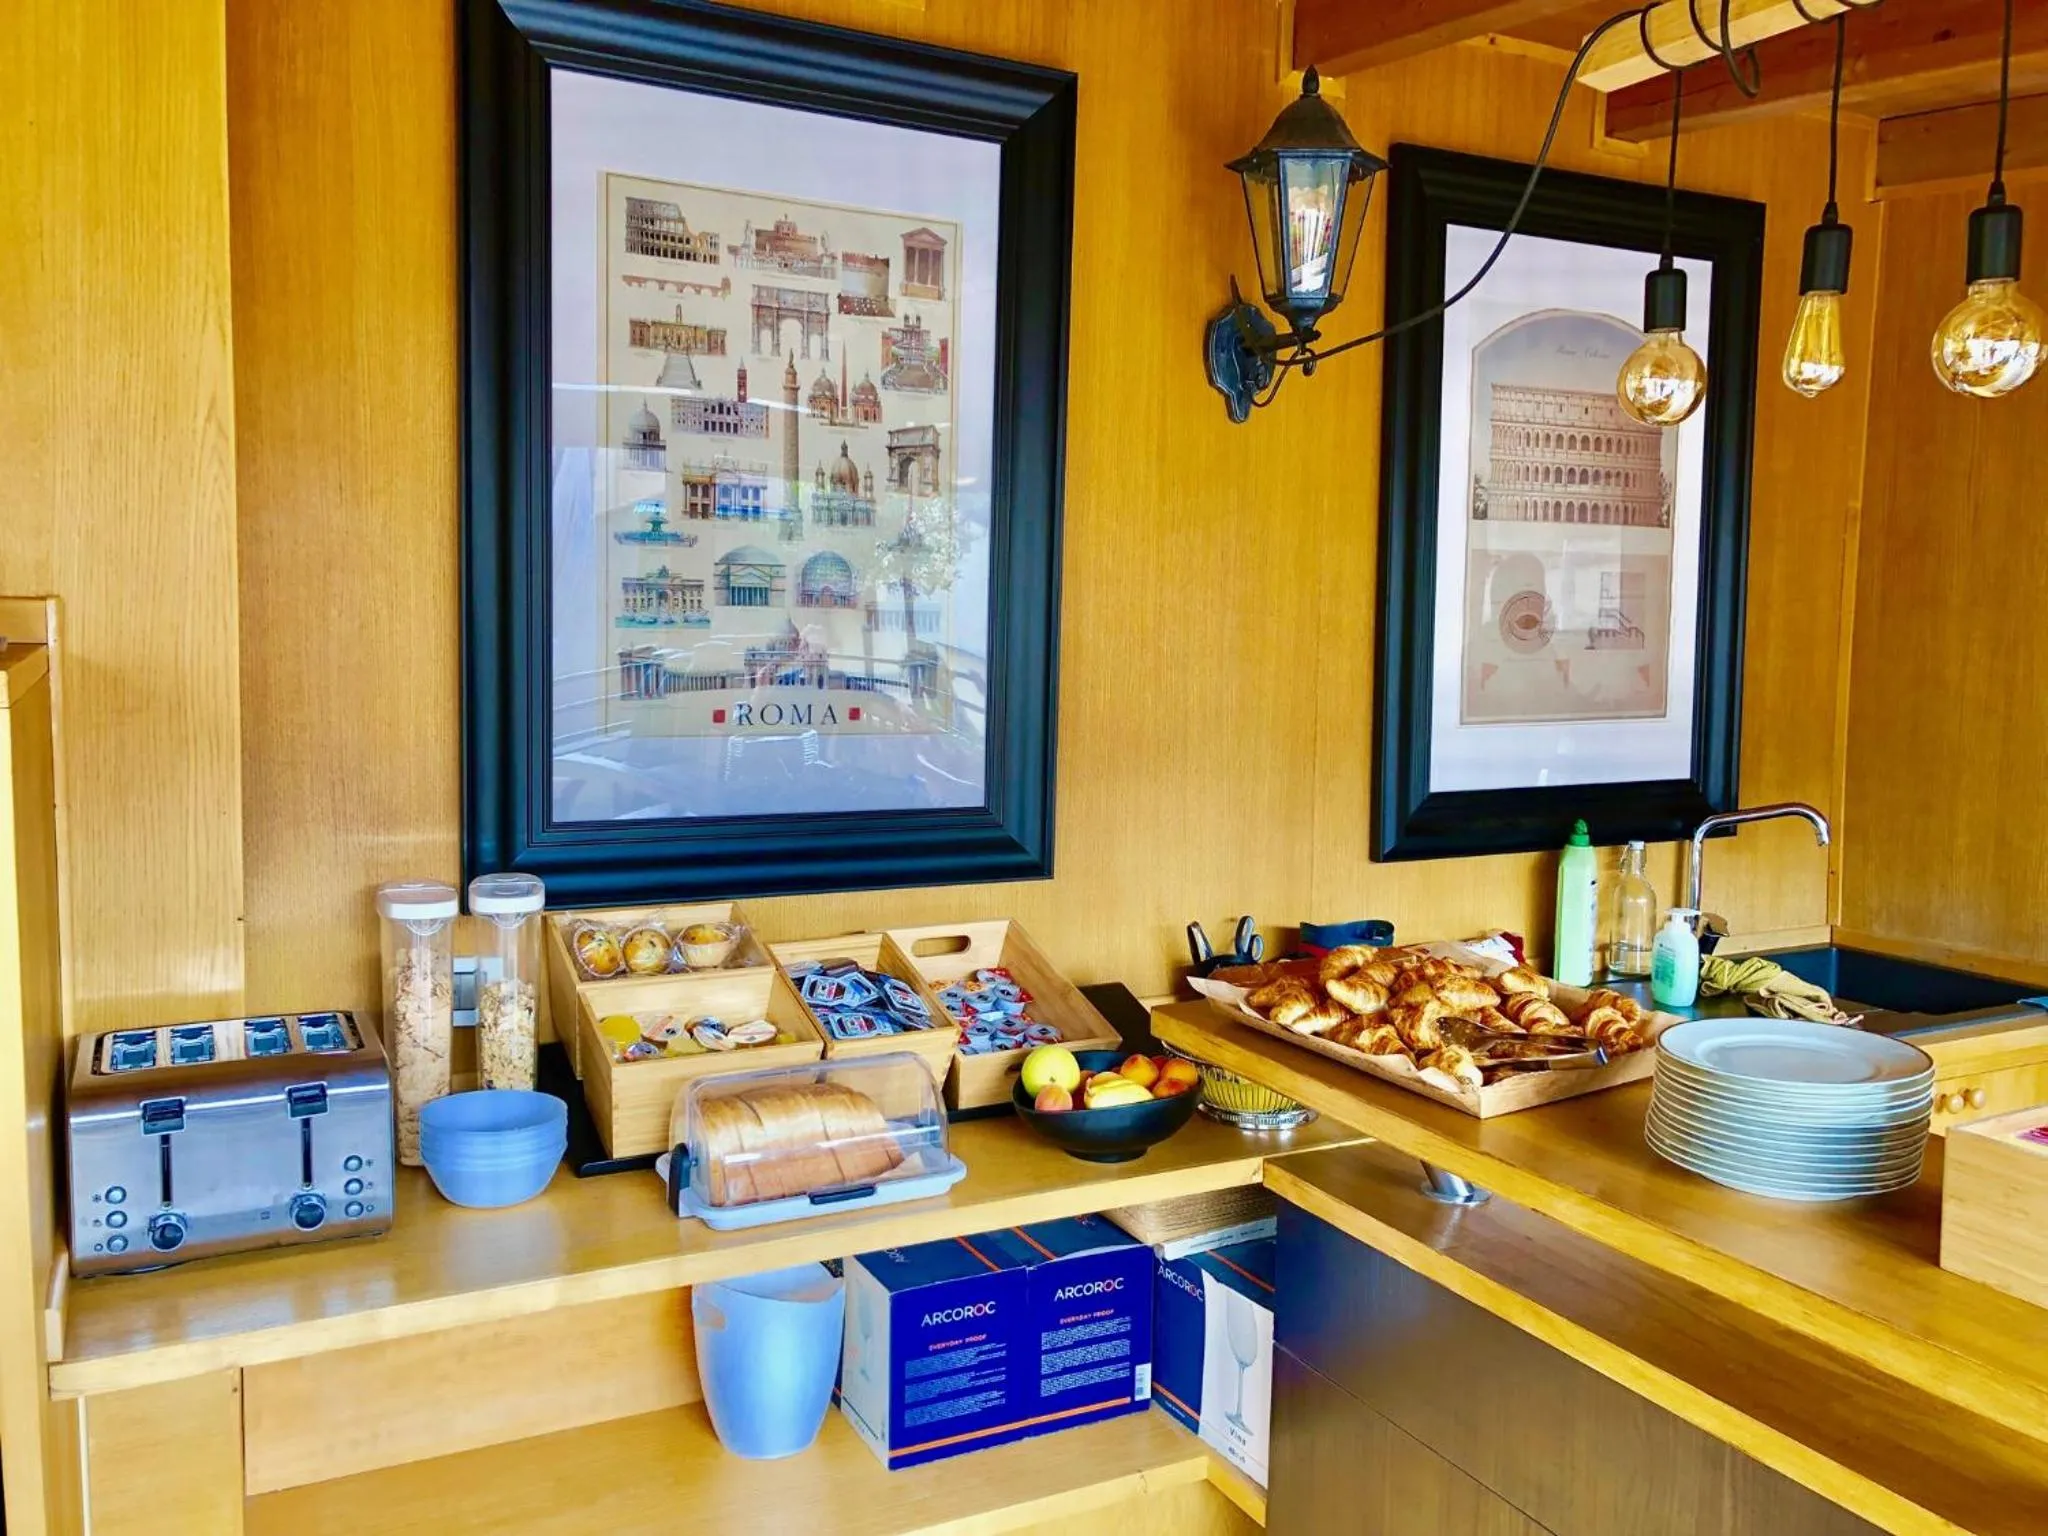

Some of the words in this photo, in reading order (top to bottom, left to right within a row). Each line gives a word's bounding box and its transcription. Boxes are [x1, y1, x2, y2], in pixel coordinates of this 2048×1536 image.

[735, 703, 839, 727] ROMA
[1053, 1277, 1125, 1302] ARCOROC
[1157, 1264, 1204, 1302] ARCOROC
[920, 1300, 997, 1328] ARCOROC
